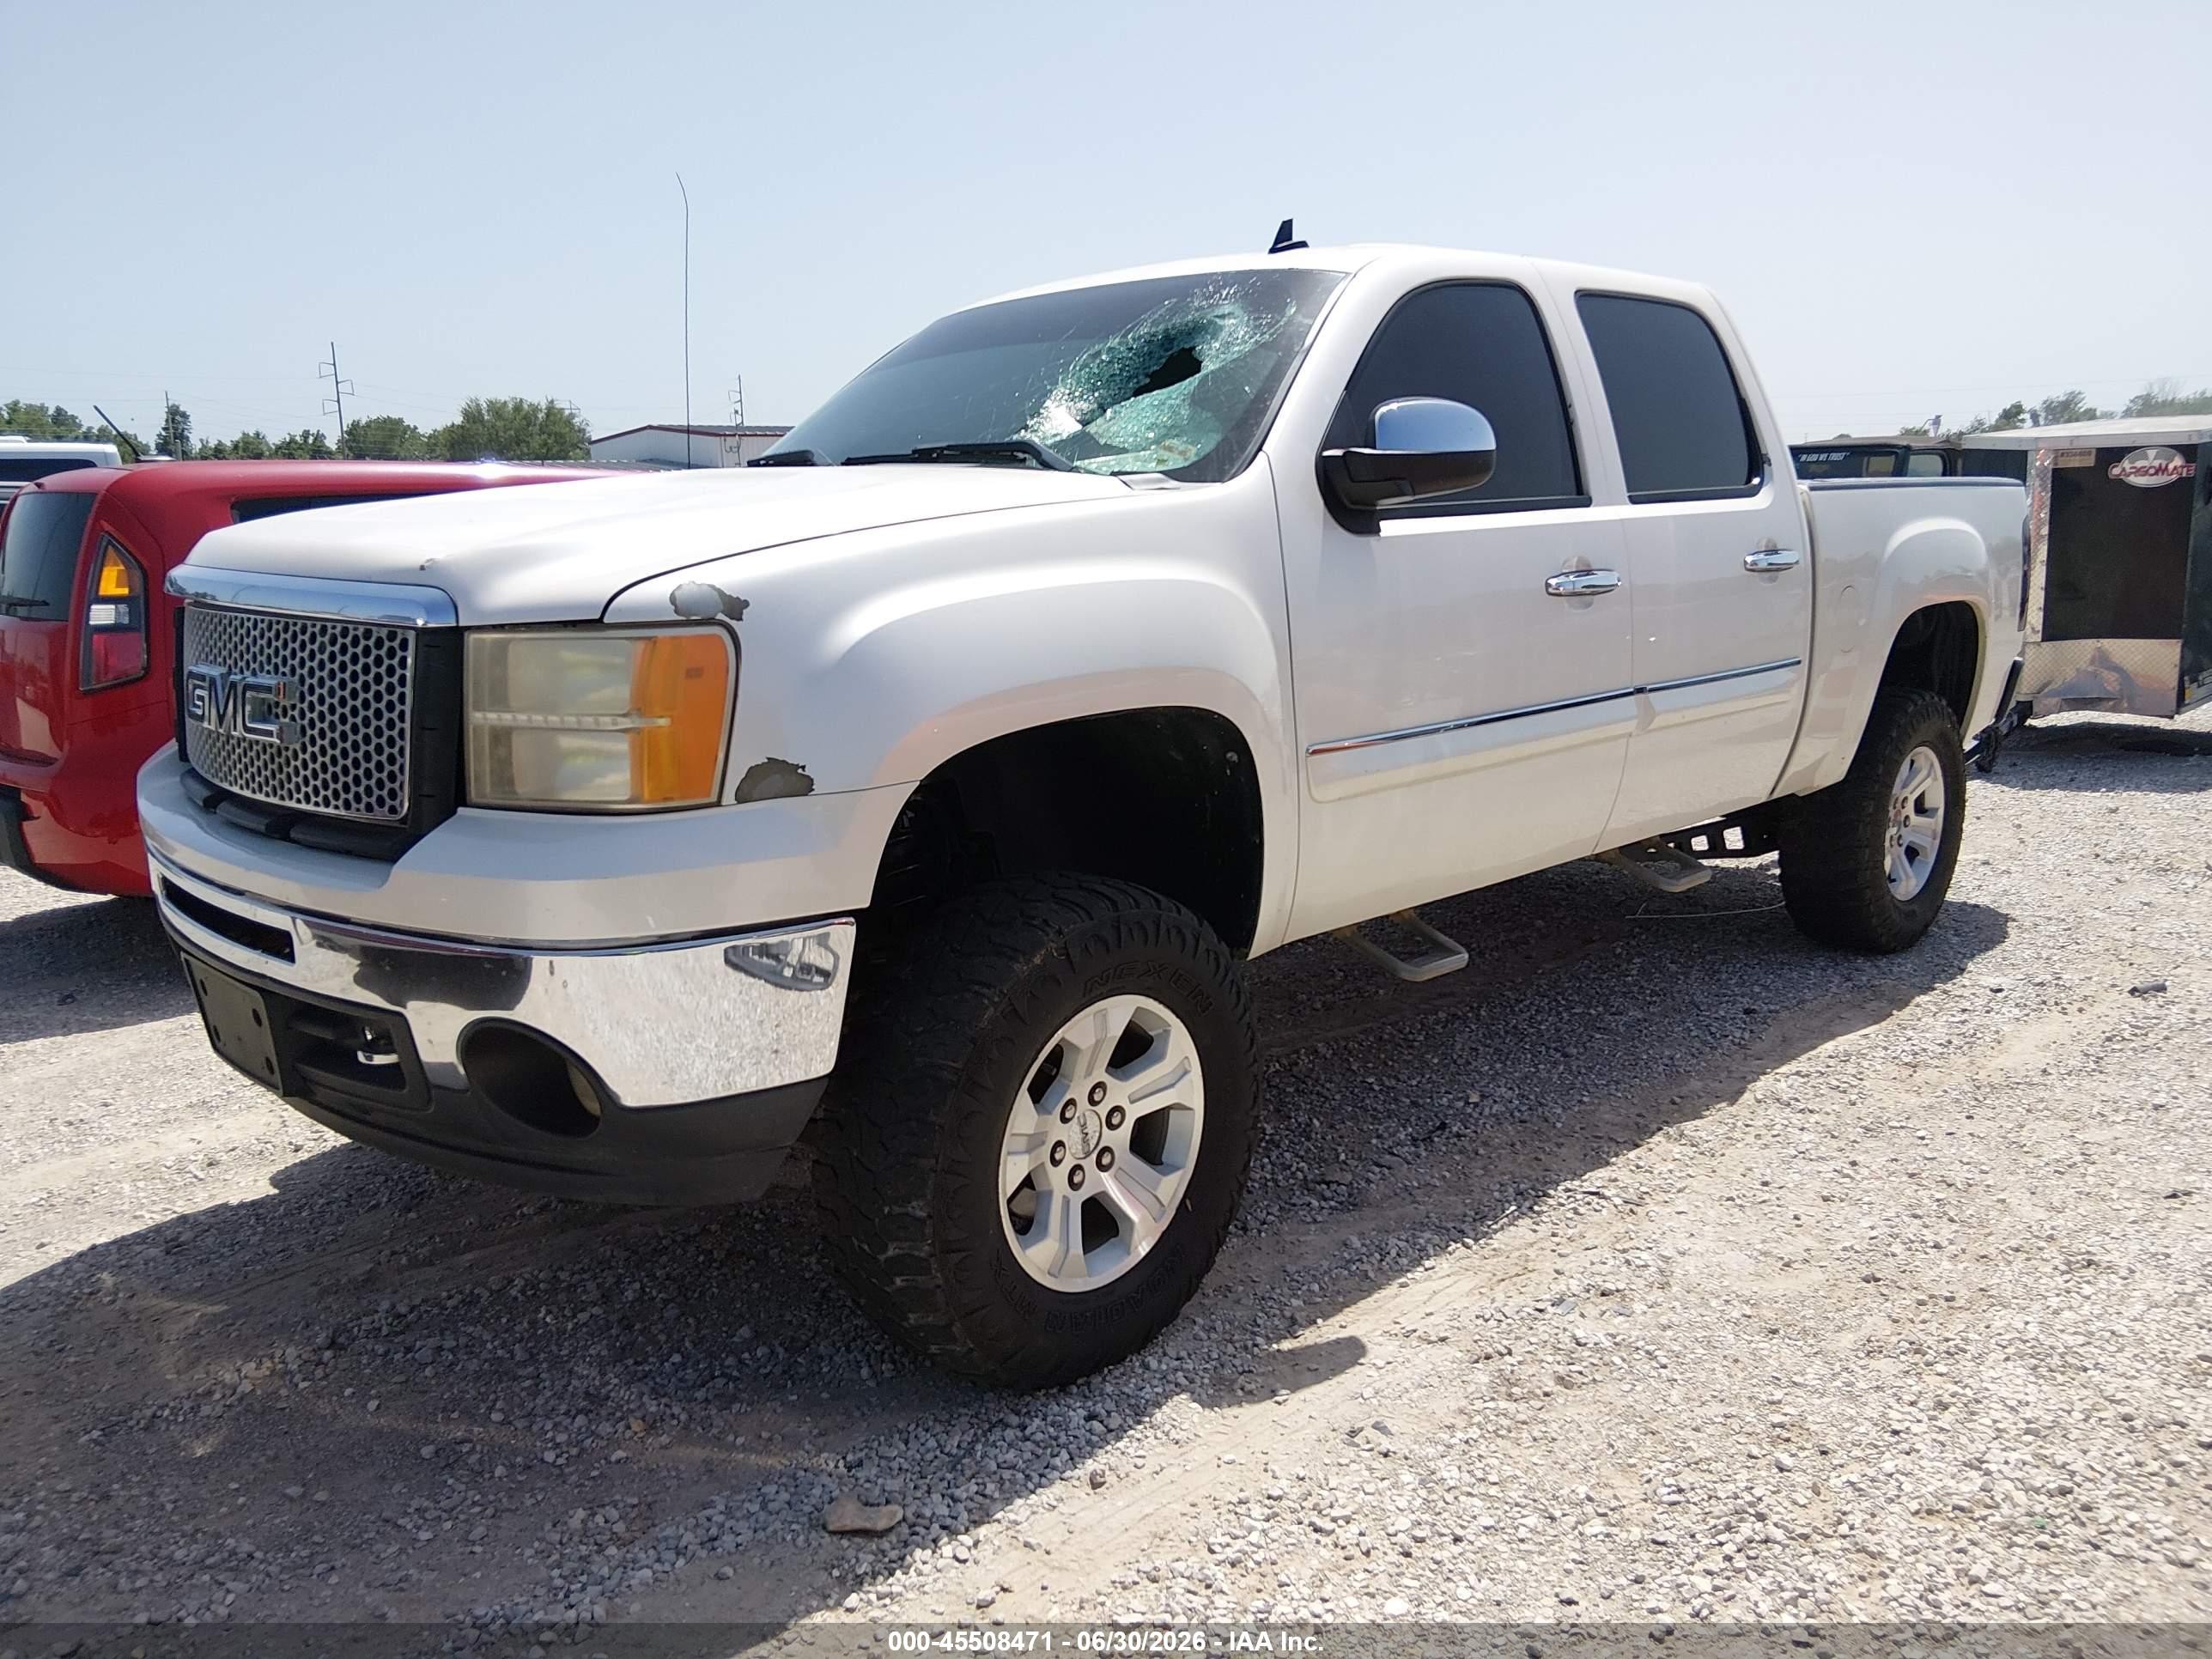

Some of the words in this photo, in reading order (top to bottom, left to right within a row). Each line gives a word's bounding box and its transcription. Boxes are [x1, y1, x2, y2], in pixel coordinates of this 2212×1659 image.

[1819, 453, 1829, 461] WE
[186, 664, 299, 745] GMC
[1081, 959, 1216, 1017] NEXEN
[1077, 1112, 1091, 1155] GMC
